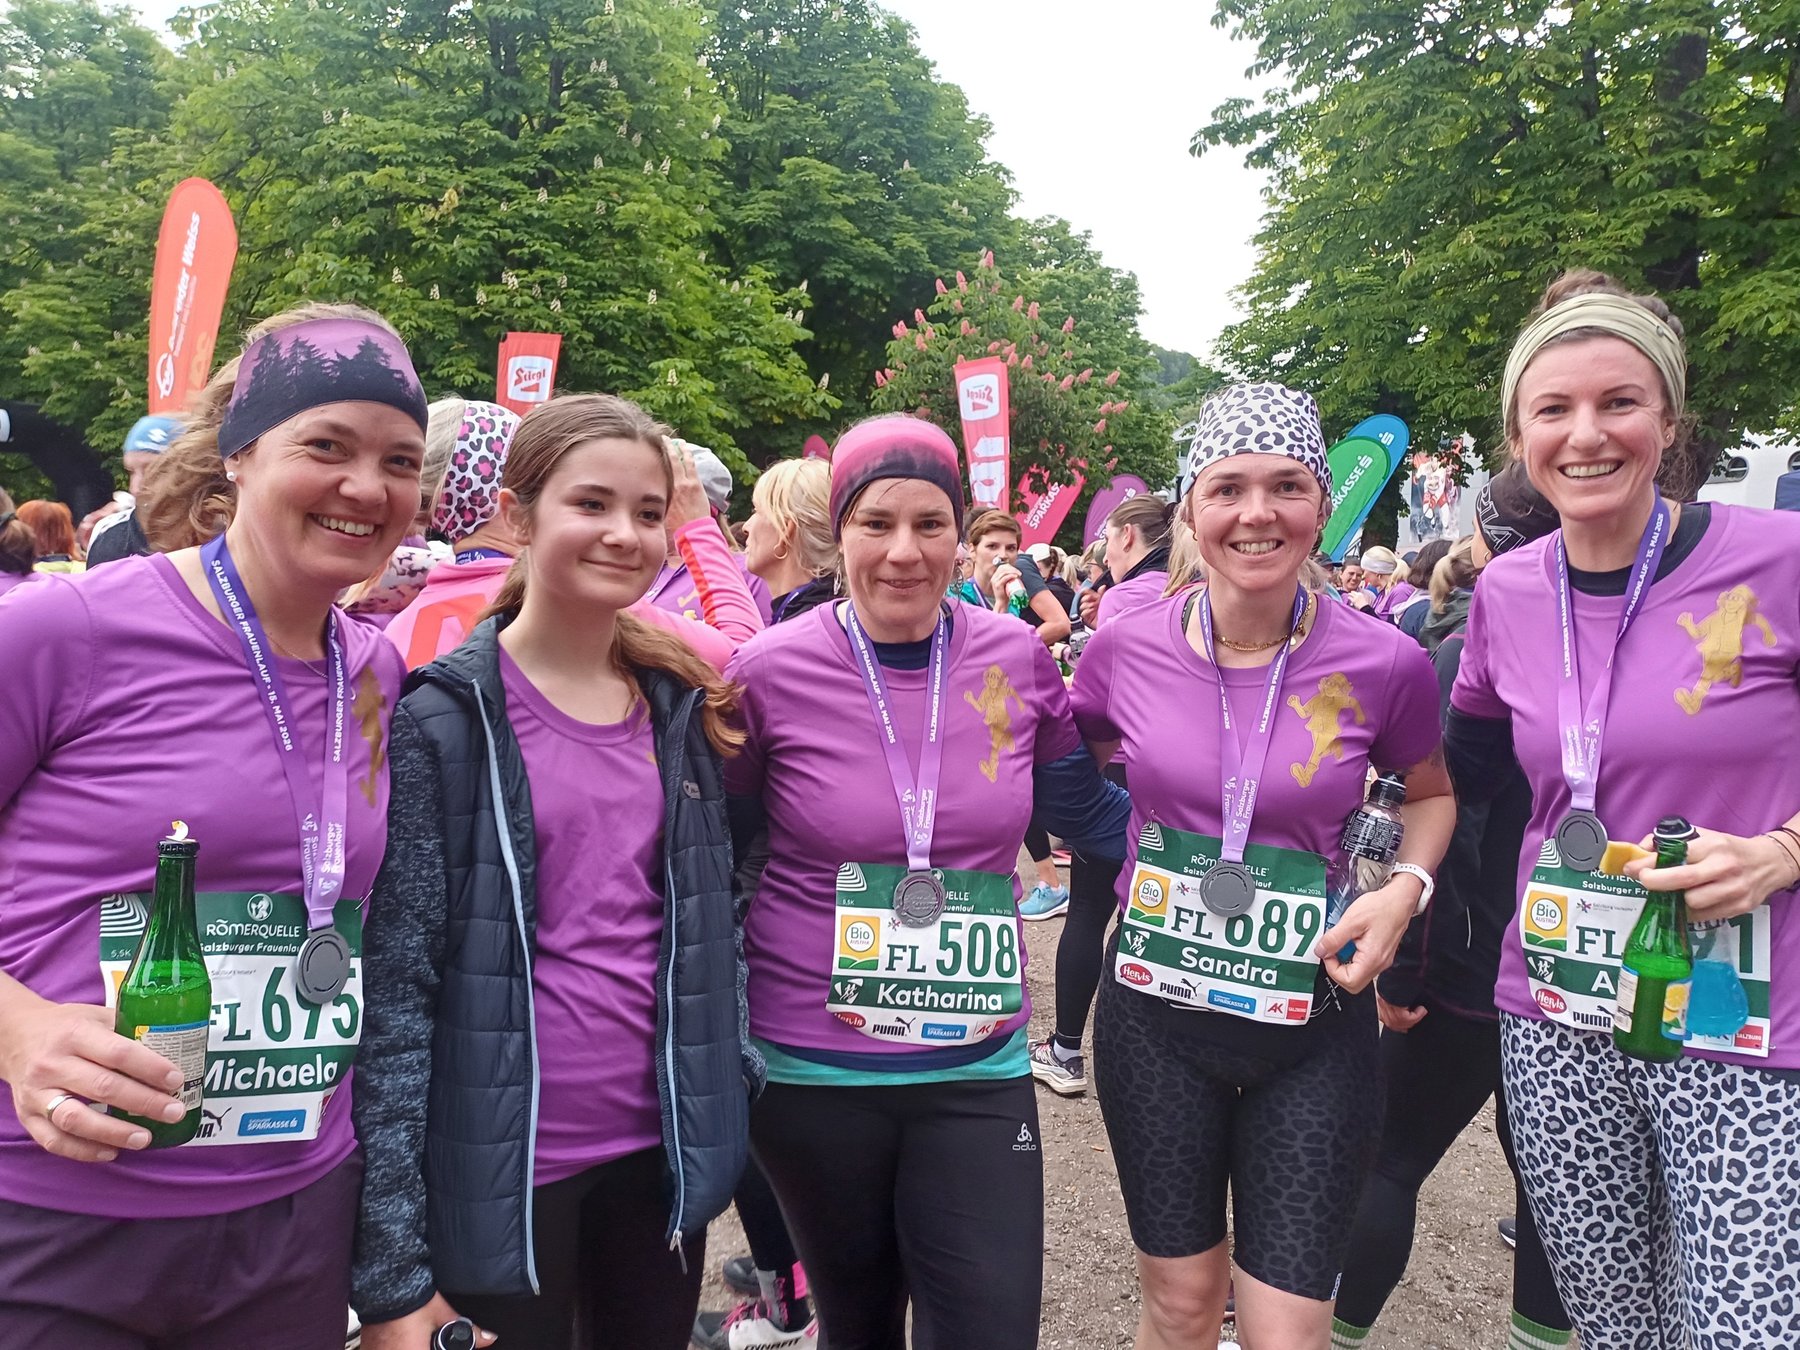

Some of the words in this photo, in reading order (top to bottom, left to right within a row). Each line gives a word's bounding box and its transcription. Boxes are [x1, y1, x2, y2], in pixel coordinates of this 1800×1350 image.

[182, 211, 200, 267] Weiss
[514, 367, 546, 386] Stiegl
[1331, 466, 1365, 511] RKASSE
[1627, 562, 1648, 616] FRAUENLAUF
[1650, 532, 1660, 547] MAI
[211, 559, 245, 621] SALZBURGER
[239, 620, 271, 684] FRAUENLAUF
[273, 705, 285, 723] MAI
[862, 650, 882, 697] FRAUENLAUF
[934, 648, 944, 694] FRAUENLAUF
[881, 710, 890, 725] MAI
[929, 694, 940, 743] SALZBURGER
[1259, 685, 1276, 734] SALZBURGER
[333, 701, 345, 763] SALZBURGER
[885, 724, 896, 744] 2026
[917, 788, 928, 828] Salzburger
[1236, 778, 1250, 817] Salzburger
[1243, 779, 1257, 818] Frauenlauf
[321, 821, 336, 873] Salzburger
[331, 822, 343, 874] Frauenlauf
[1142, 882, 1159, 898] Bio
[1309, 888, 1321, 896] 2026
[1582, 880, 1632, 895] Salzburger
[1171, 905, 1213, 940] FL
[1535, 916, 1557, 925] AUSTRIA
[1536, 903, 1557, 919] Bio
[256, 943, 300, 953] Frauenlau
[851, 927, 870, 940] Bio
[885, 944, 927, 973] FL
[936, 920, 1018, 978] 508
[1575, 925, 1623, 960] FL
[1123, 965, 1151, 982] Hervis
[1180, 946, 1278, 985] Sandra
[877, 982, 1003, 1011] Katharina
[1160, 982, 1192, 999] PUMA
[1267, 1002, 1284, 1014] AK
[1537, 990, 1565, 1009] Hervis
[872, 1023, 906, 1037] PUMA
[1572, 1011, 1611, 1028] PUMA
[204, 1054, 338, 1092] Michaela
